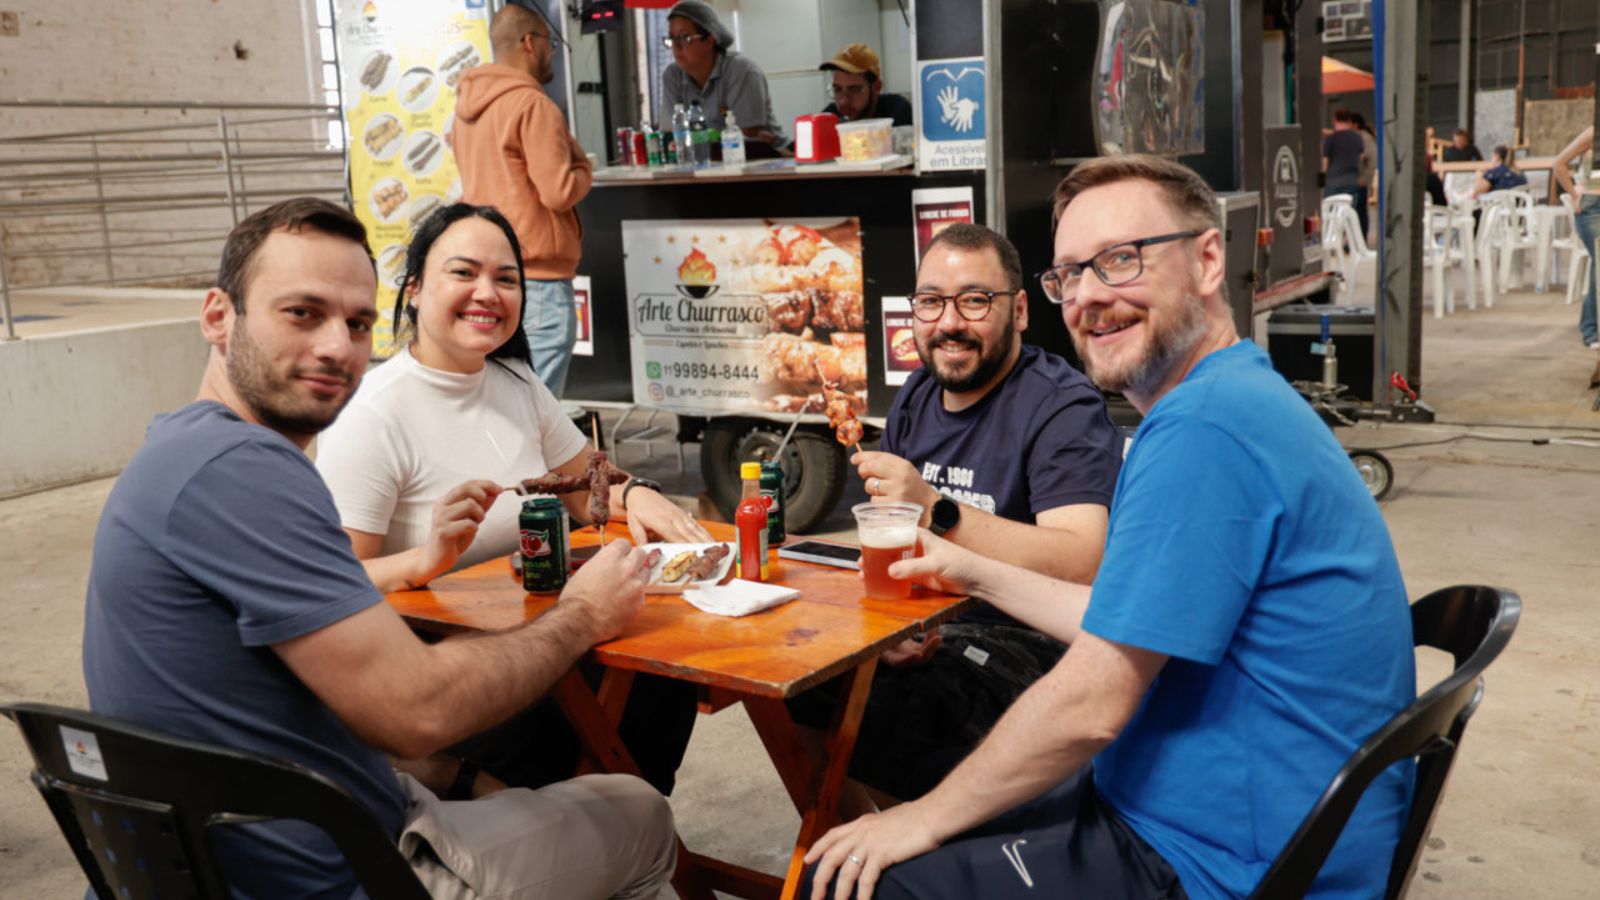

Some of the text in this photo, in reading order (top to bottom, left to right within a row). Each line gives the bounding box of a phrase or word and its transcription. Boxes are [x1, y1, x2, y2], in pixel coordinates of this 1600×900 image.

[930, 159, 949, 167] em
[638, 298, 764, 323] Arte Churrasco
[673, 362, 759, 380] 99894-8444
